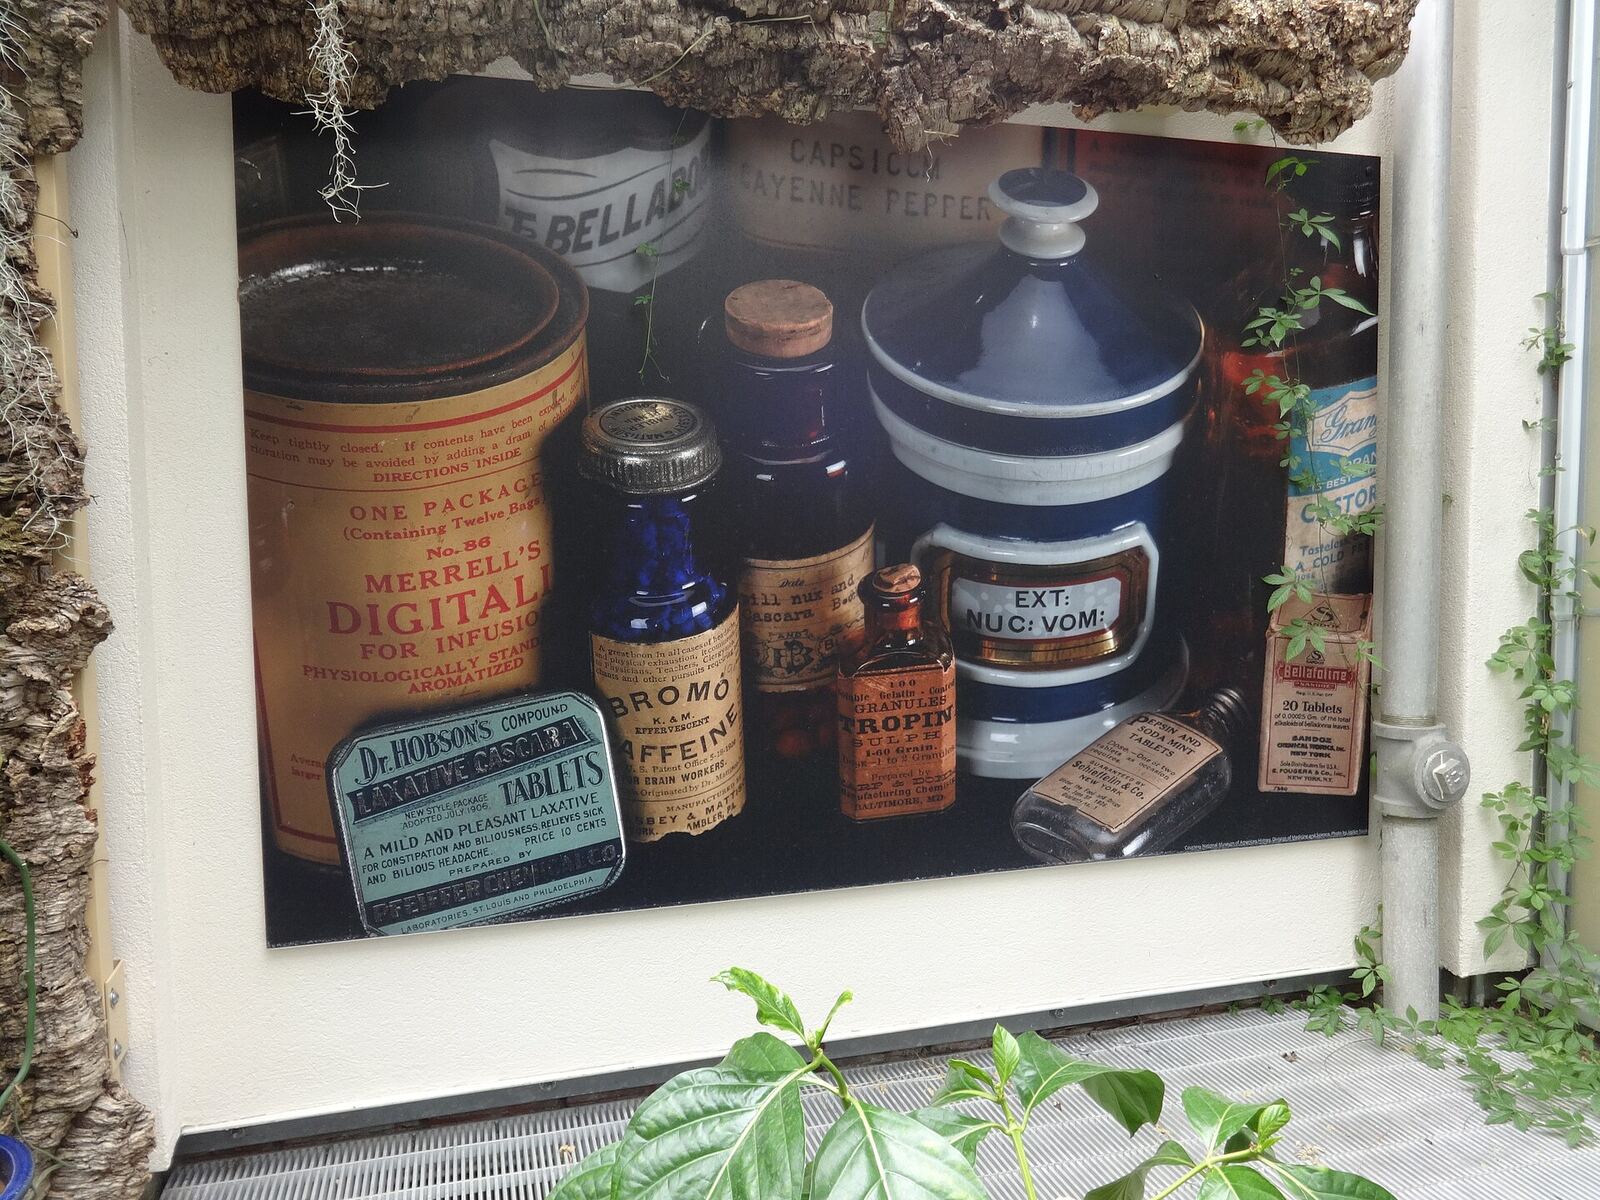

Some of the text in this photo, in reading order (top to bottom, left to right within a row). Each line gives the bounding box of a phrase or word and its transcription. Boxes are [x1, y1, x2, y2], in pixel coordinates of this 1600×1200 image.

[288, 437, 330, 453] tightly
[423, 433, 474, 450] contents
[480, 425, 505, 438] have
[511, 413, 533, 429] been
[307, 456, 335, 468] may
[343, 458, 358, 468] be
[366, 456, 415, 469] avoided
[424, 454, 439, 466] by
[446, 446, 486, 463] adding
[492, 443, 499, 451] a
[505, 432, 531, 447] dram
[373, 447, 522, 484] DIRECTIONS INSIDE
[350, 472, 543, 521] ONE PACKAGE
[1300, 485, 1376, 524] CSTOR
[343, 523, 447, 541] (Containing
[451, 510, 505, 530] Twelve
[364, 540, 541, 594] MERRELL'S
[1313, 550, 1344, 569] COLD
[831, 574, 855, 595] and
[1015, 589, 1070, 609] EXT:
[360, 642, 419, 660] FOR
[302, 656, 480, 683] PHYSIOLOGICALLY
[407, 657, 524, 695] AROMATIZED
[622, 666, 705, 683] and other pursuits
[1284, 664, 1347, 681] Bellafoline
[608, 677, 729, 719] BROMO
[855, 695, 947, 714] GRANULES
[1282, 699, 1343, 714] 20 Tablets
[501, 703, 568, 732] COMPOUND
[635, 715, 710, 735] EFFERVESCENT
[653, 716, 665, 726] K.
[681, 711, 696, 721] M.
[1127, 715, 1202, 748] PEPSIN AND
[1137, 725, 1196, 755] SODA MINT
[1291, 735, 1332, 744] SANDOZ
[1096, 743, 1122, 757] tablets
[1129, 732, 1175, 757] TABLETS
[1309, 751, 1332, 759] YORK
[645, 775, 676, 785] BRAIN
[681, 759, 728, 783] WORKERS.
[652, 757, 708, 773] Patent Office
[886, 757, 898, 765] to
[1089, 760, 1135, 782] GUARANTEED
[1161, 765, 1176, 776] two
[498, 750, 604, 806] TABLETS
[871, 770, 913, 781] Prepared
[1072, 760, 1145, 800] Schieffelin & Co.
[1080, 774, 1122, 796] NEW YORK
[640, 784, 688, 798] Originated
[666, 783, 736, 813] MANUFACTURED
[402, 814, 443, 831] ADOPTED
[444, 807, 466, 821] JULY
[404, 794, 488, 821] NEW STYLE PACKAGE
[686, 812, 697, 821] &
[364, 792, 599, 860] A MILD AND PLEASANT LAXATIVE
[362, 806, 605, 874] FOR CONSTIPATION AND RELIEVES SICK
[367, 875, 387, 886] AND
[393, 863, 435, 879] BILIOUS
[525, 831, 555, 847] PRICE
[561, 826, 571, 837] 10
[576, 818, 607, 834] CENTS
[449, 849, 532, 876] PREPARED BY
[513, 893, 530, 904] AND
[534, 876, 594, 898] PHILADELPHIA
